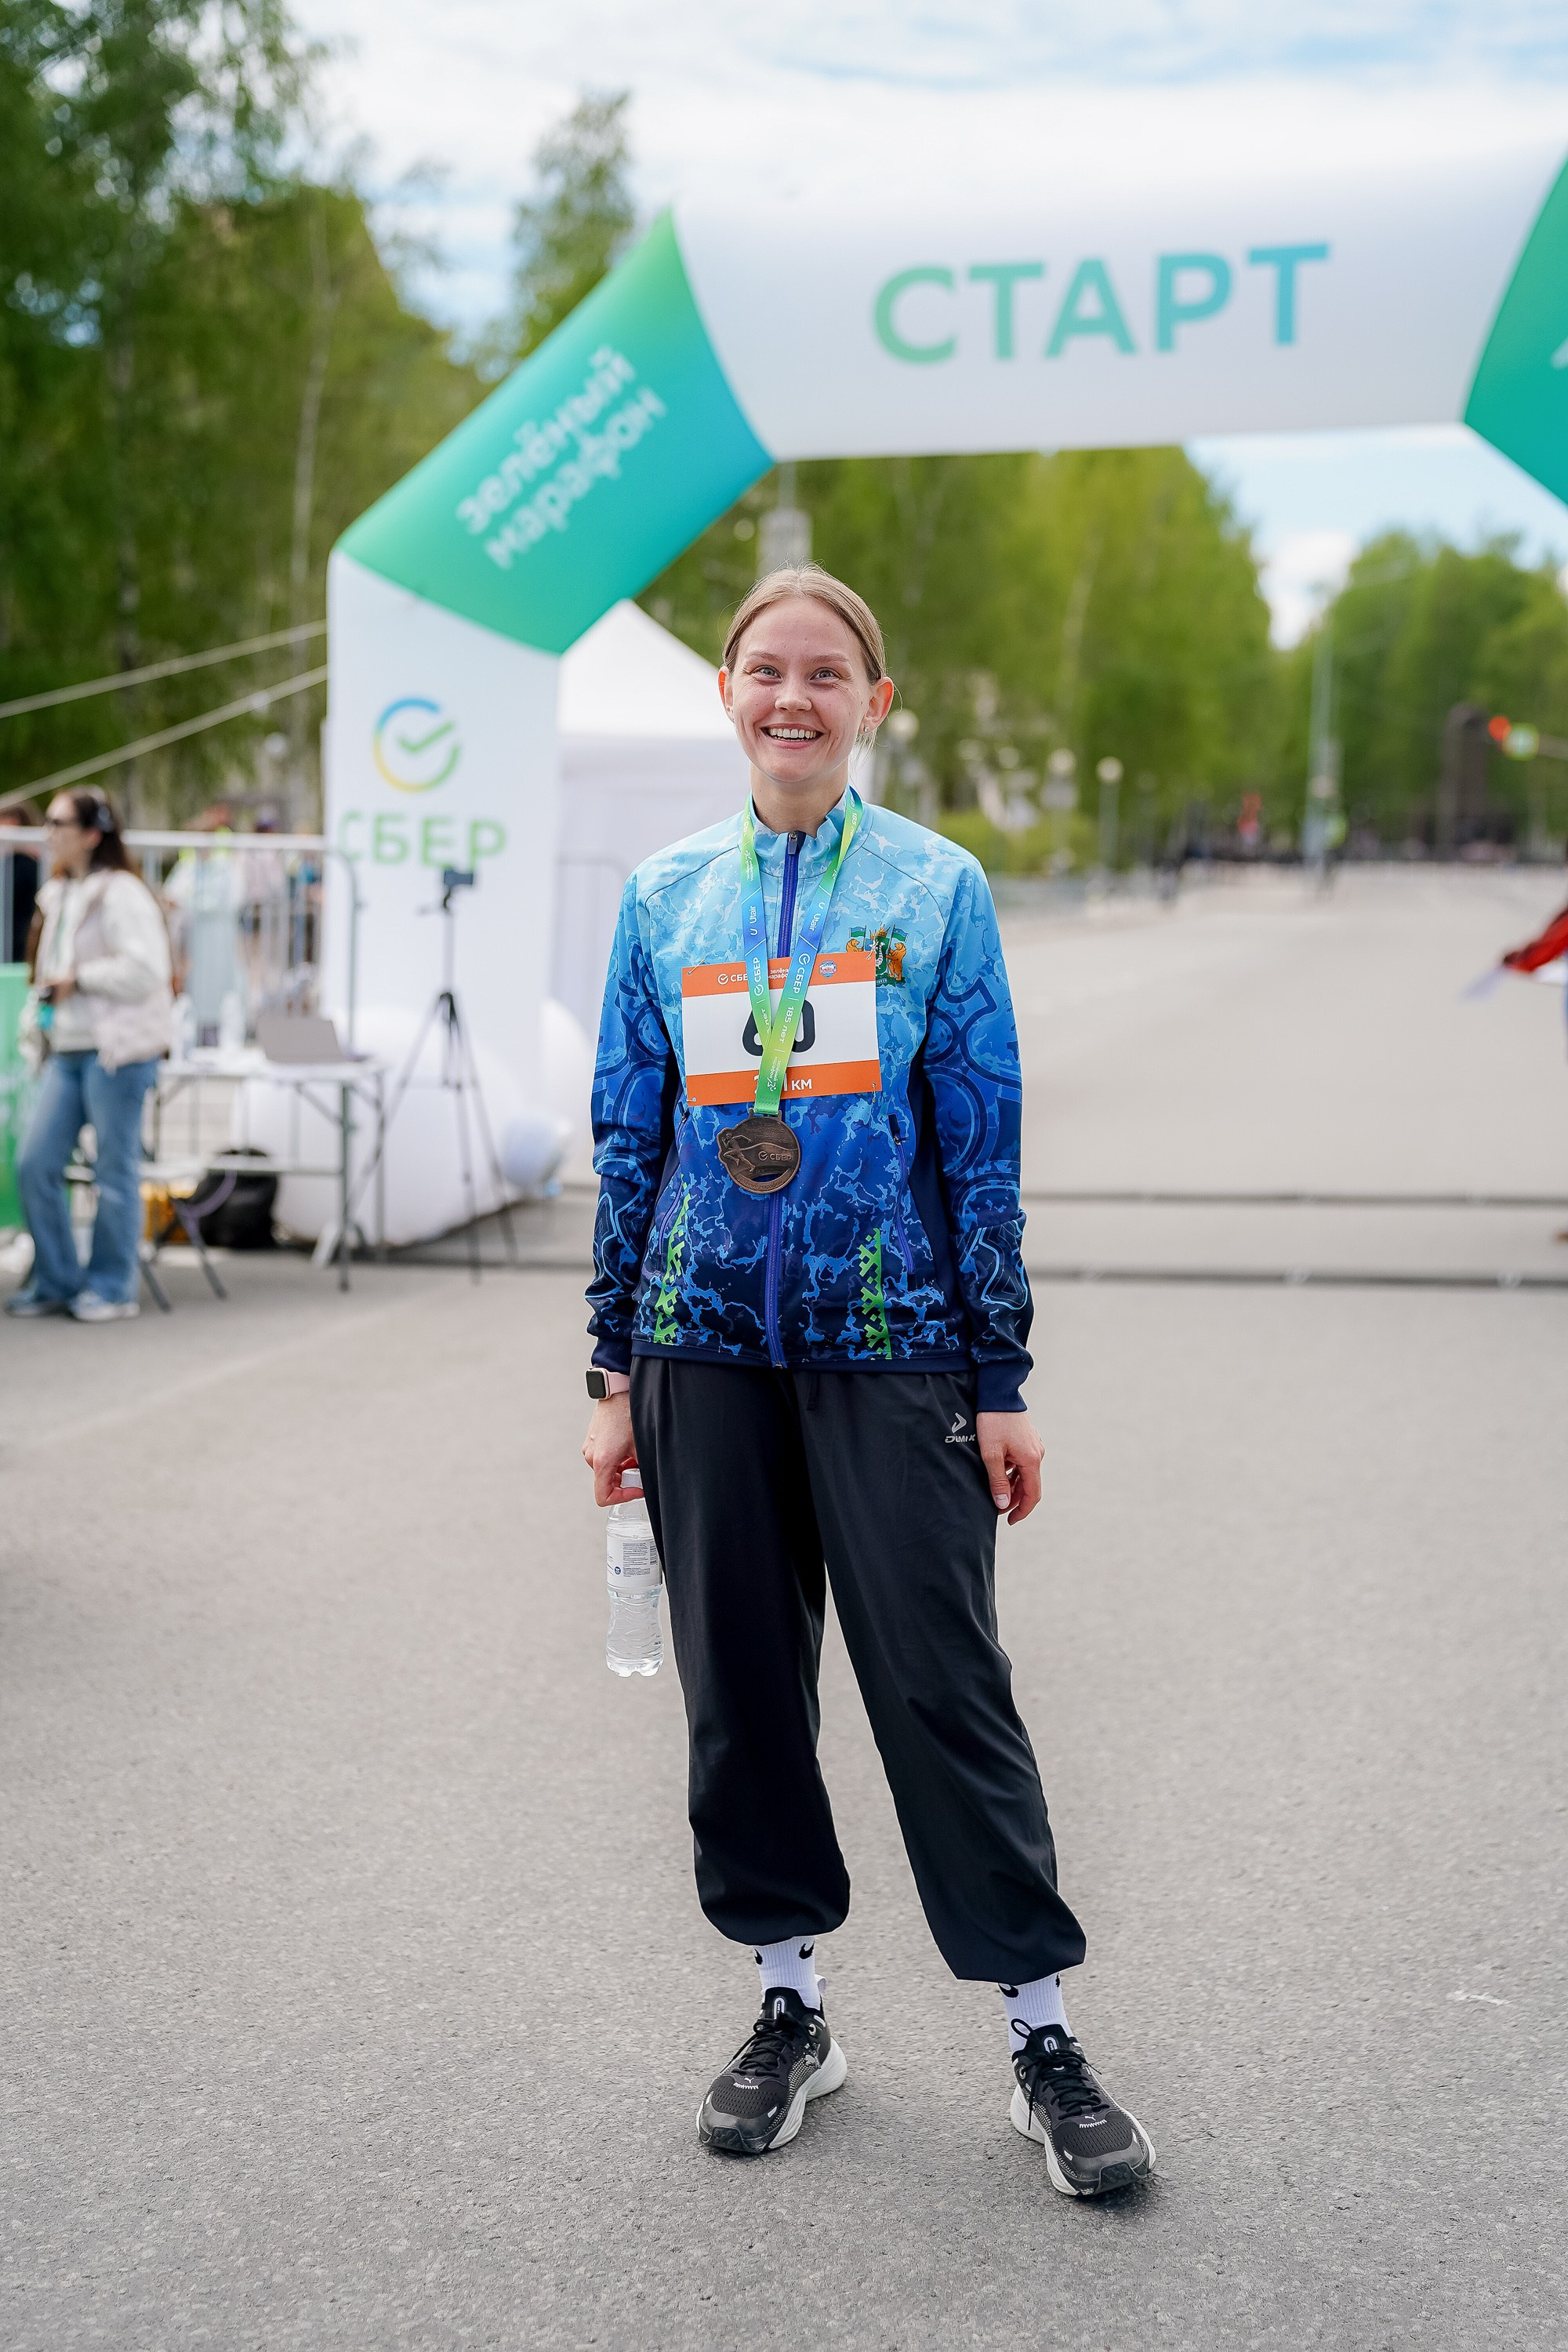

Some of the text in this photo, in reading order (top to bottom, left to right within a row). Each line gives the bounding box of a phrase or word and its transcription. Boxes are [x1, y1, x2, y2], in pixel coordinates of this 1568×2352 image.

[871, 241, 1330, 366] СТАРТ
[456, 345, 636, 534] зелёный
[485, 387, 668, 570] марафон
[337, 809, 508, 871] СБЕР
[809, 913, 822, 931] Utair
[730, 973, 748, 982] СБЕ
[753, 956, 761, 982] СБЕР
[793, 967, 805, 994] СБЕР
[779, 1006, 794, 1044] 185 лет
